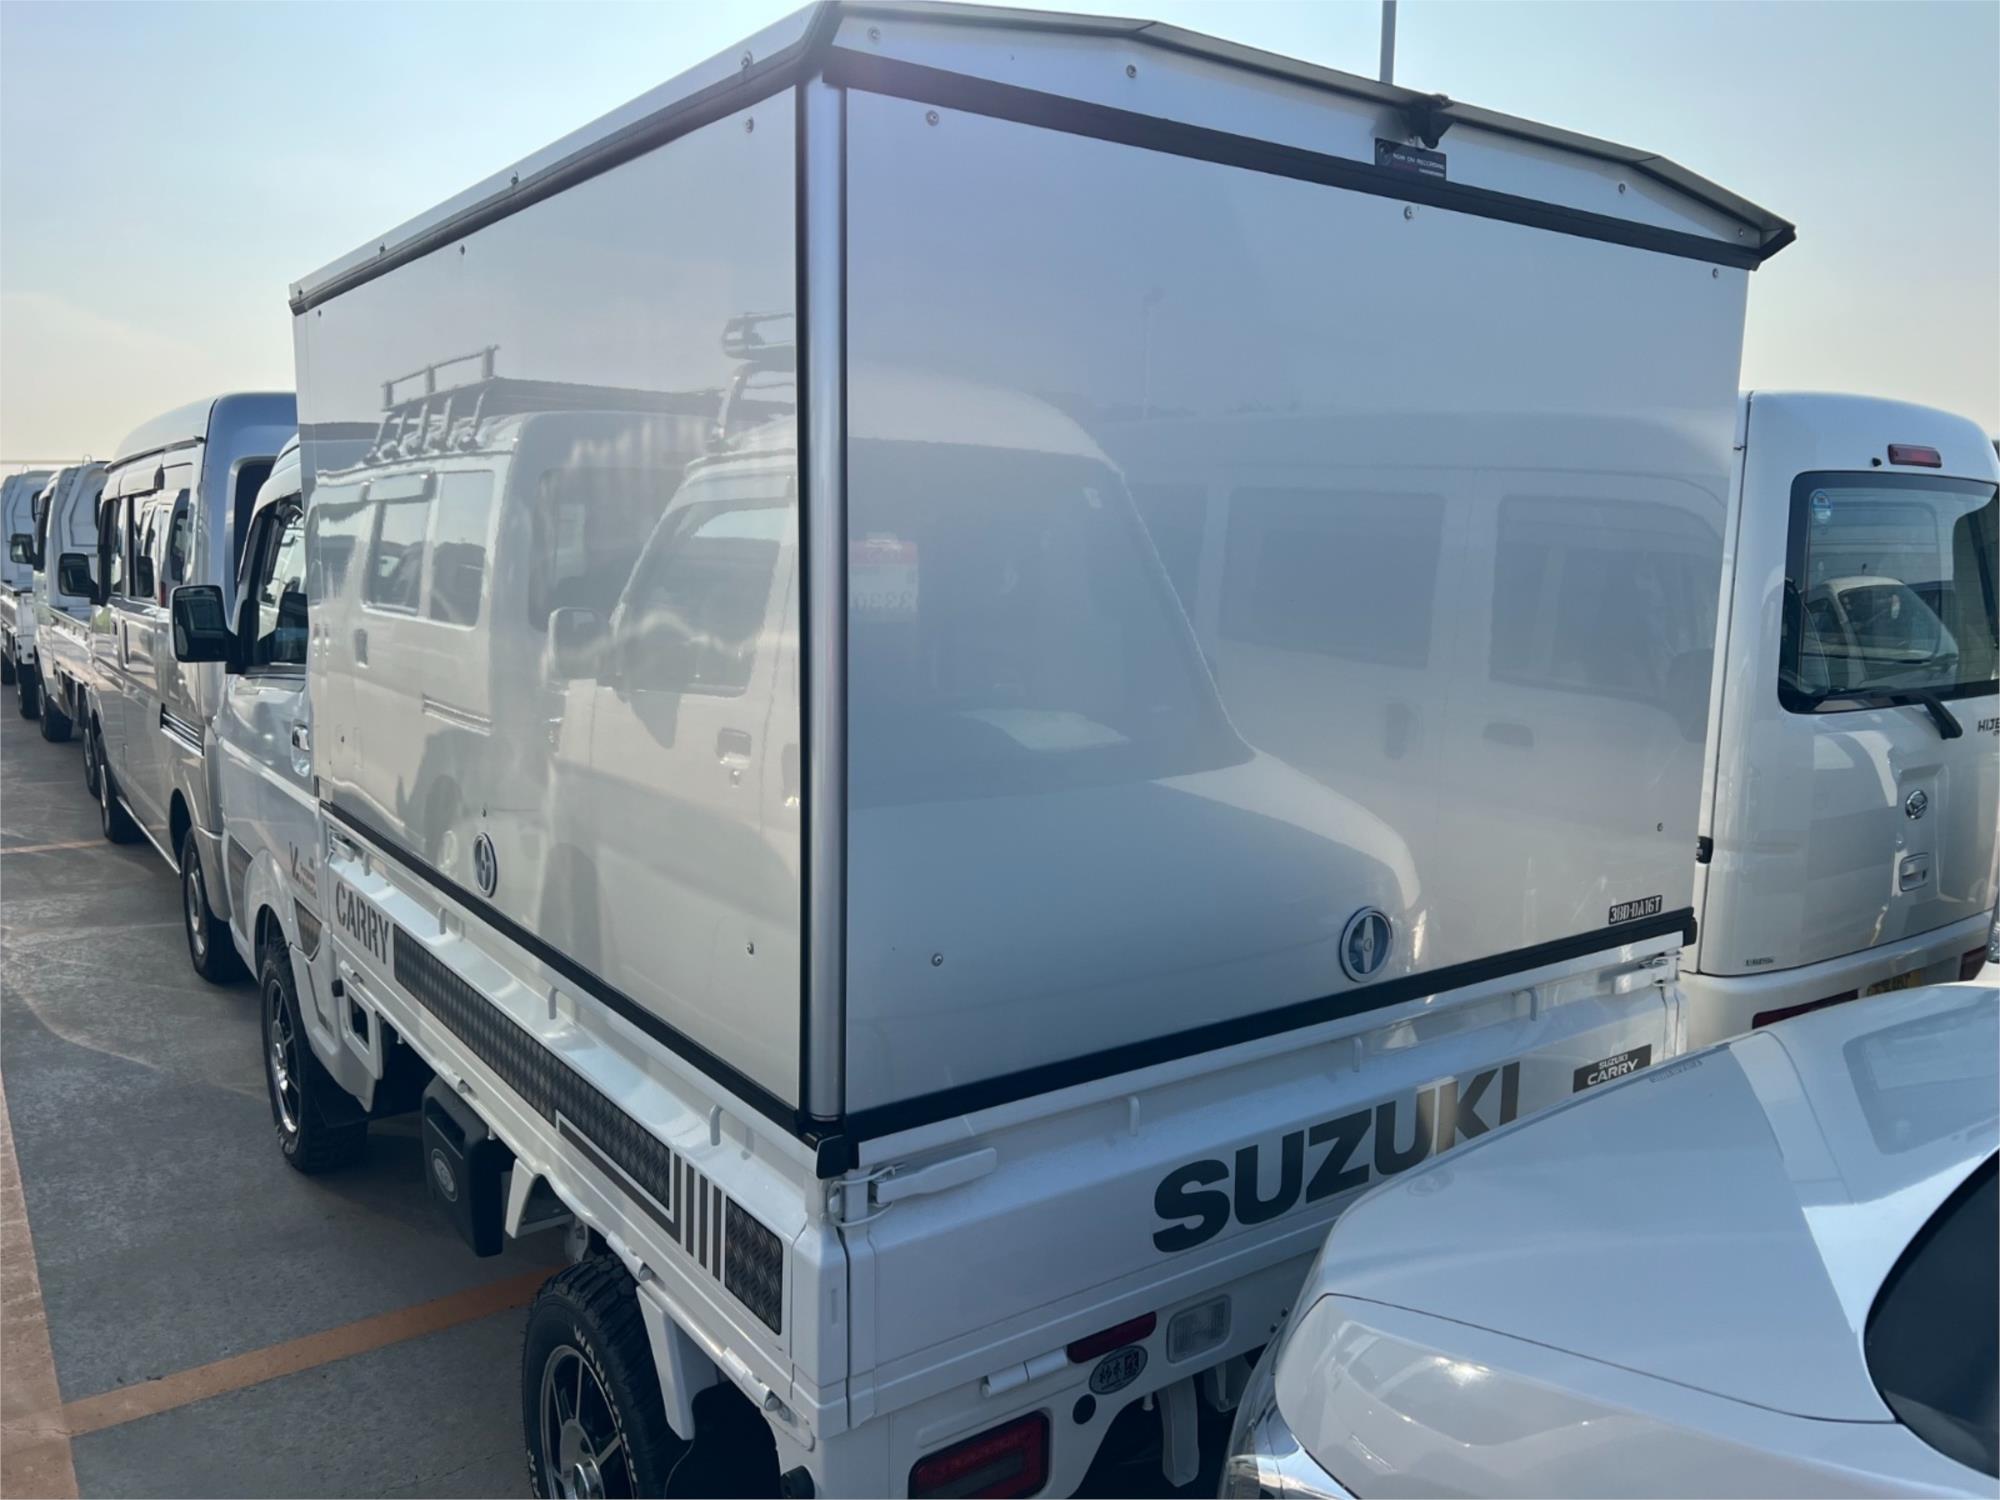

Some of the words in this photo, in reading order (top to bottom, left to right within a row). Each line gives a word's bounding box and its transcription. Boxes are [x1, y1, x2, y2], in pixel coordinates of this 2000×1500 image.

[335, 880, 390, 965] CARRY
[1587, 1058, 1639, 1086] CARRY
[1153, 1061, 1520, 1253] SUZUKI
